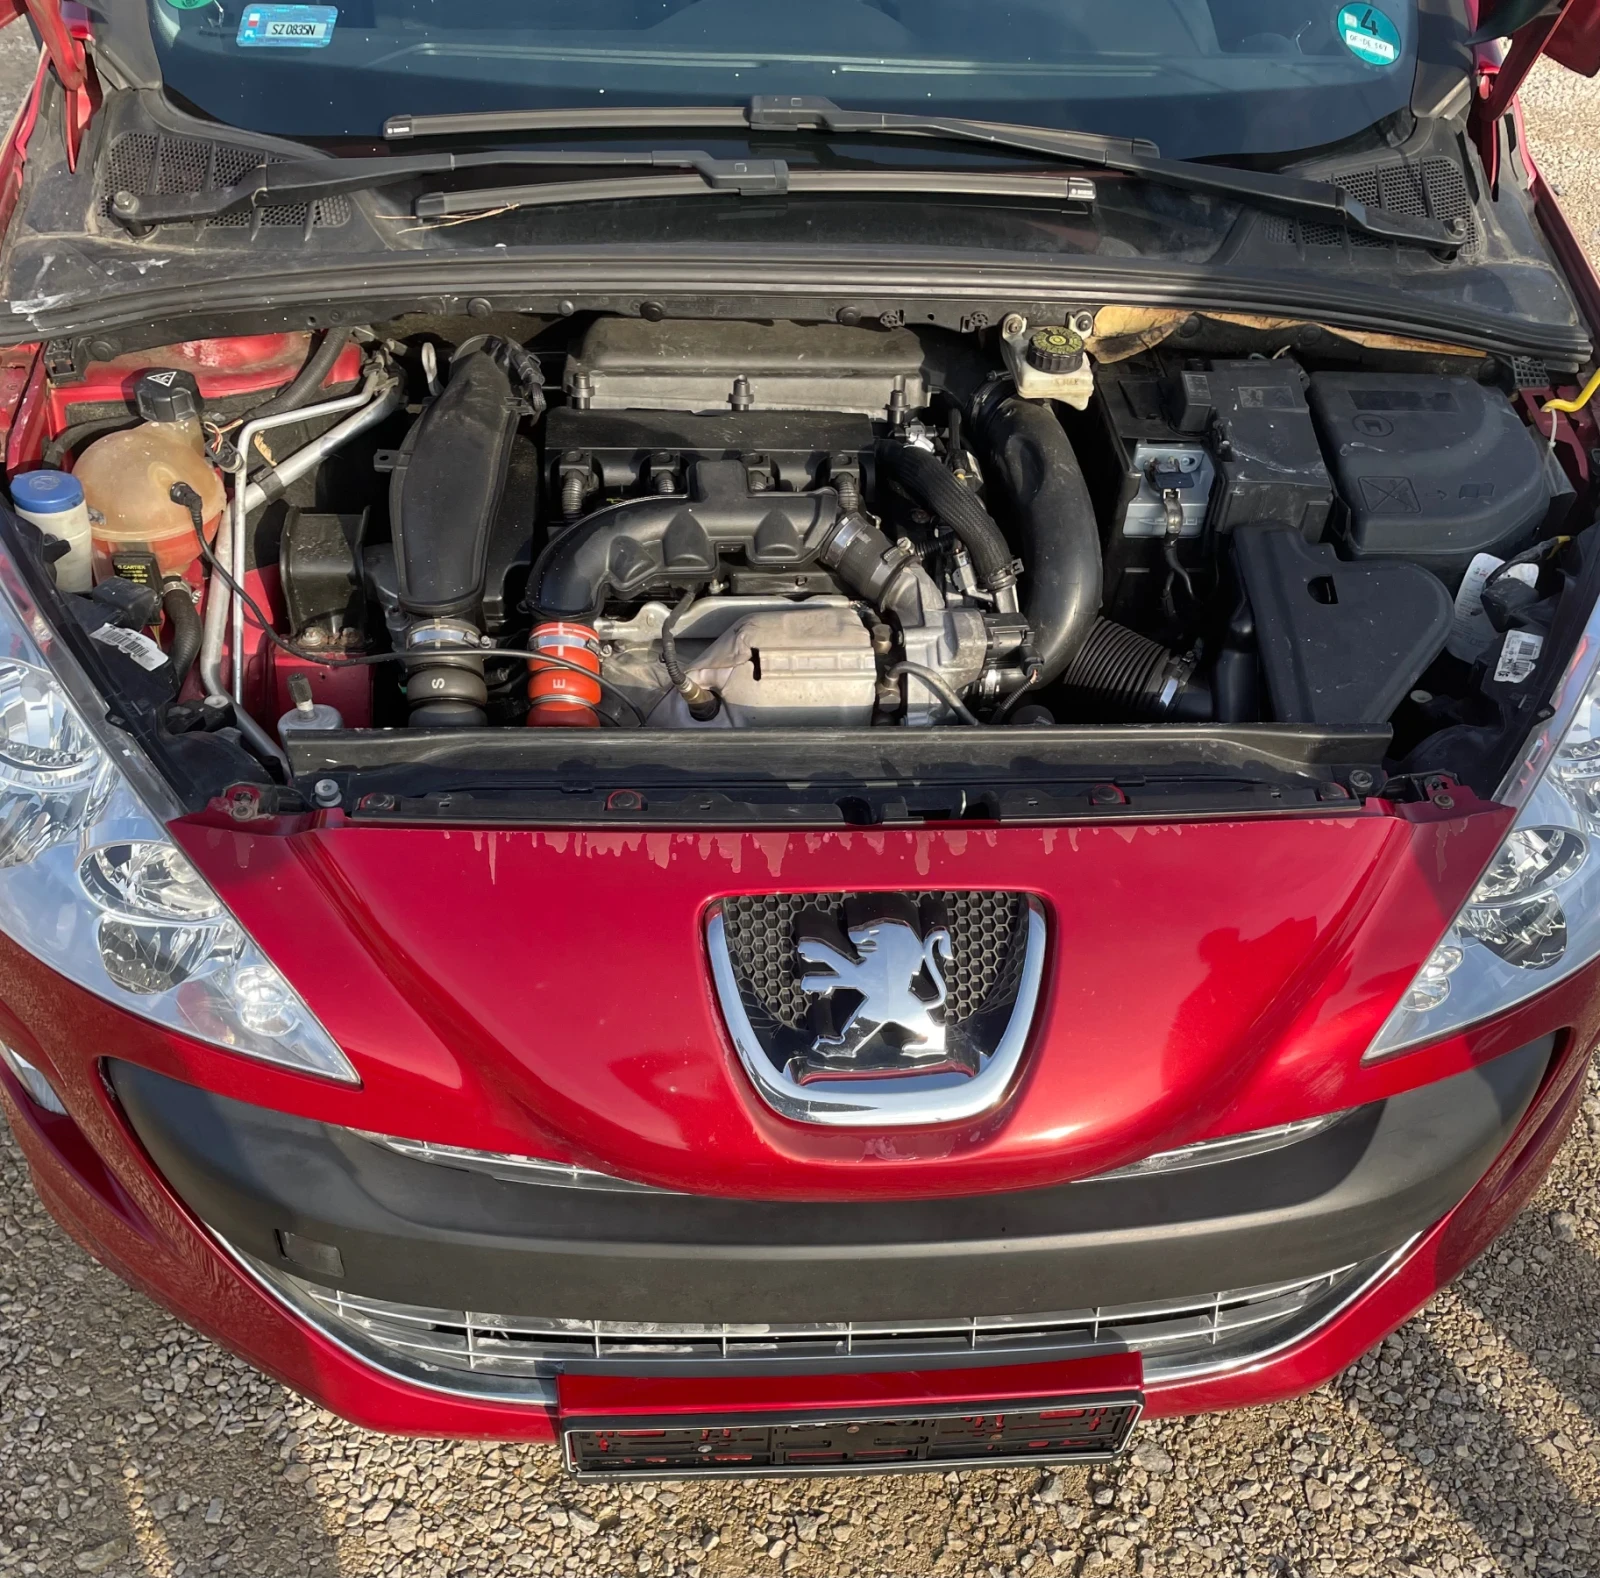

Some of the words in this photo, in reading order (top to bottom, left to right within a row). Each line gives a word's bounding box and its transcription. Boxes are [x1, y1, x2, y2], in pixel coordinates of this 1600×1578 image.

[1360, 9, 1378, 35] 4
[271, 24, 286, 35] SZ
[286, 24, 316, 36] 0835N
[431, 677, 446, 689] S
[552, 678, 566, 689] E
